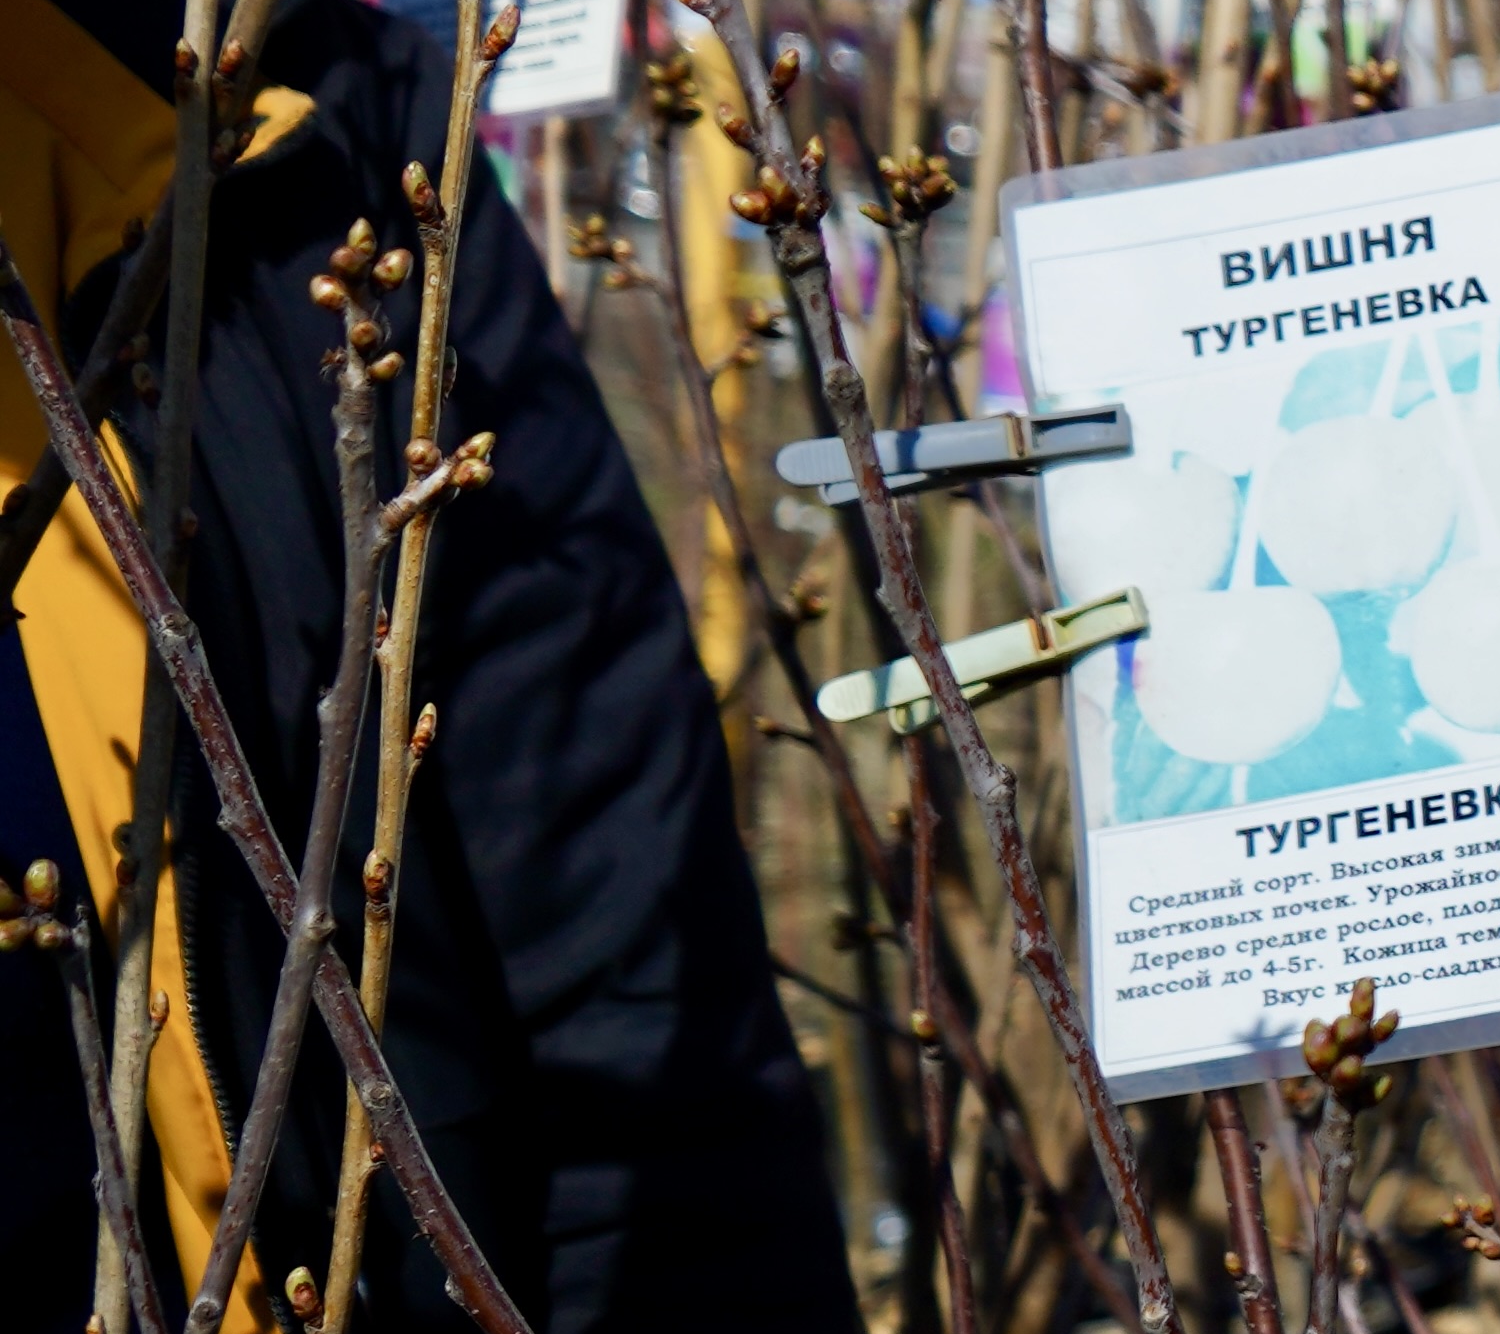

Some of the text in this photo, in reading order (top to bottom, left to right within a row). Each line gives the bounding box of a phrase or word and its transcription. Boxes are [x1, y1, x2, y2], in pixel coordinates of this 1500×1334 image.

[1219, 215, 1437, 290] ВИШНЯ
[1182, 275, 1490, 358] ТУРГЕНЕВКА
[1128, 877, 1245, 916] Средний
[1253, 870, 1321, 894] сорт.
[1331, 848, 1444, 881] Высокая
[1115, 907, 1264, 945] цветковых
[1272, 893, 1357, 921] почек.
[1130, 943, 1226, 974] Дерево
[1235, 926, 1328, 956] средне
[1337, 911, 1433, 942] рослое,
[1115, 970, 1213, 1002] массой
[1220, 966, 1253, 987] до
[1262, 956, 1325, 977] 4-5г.
[1343, 935, 1448, 966] Кожица
[1262, 985, 1326, 1008] Вкус
